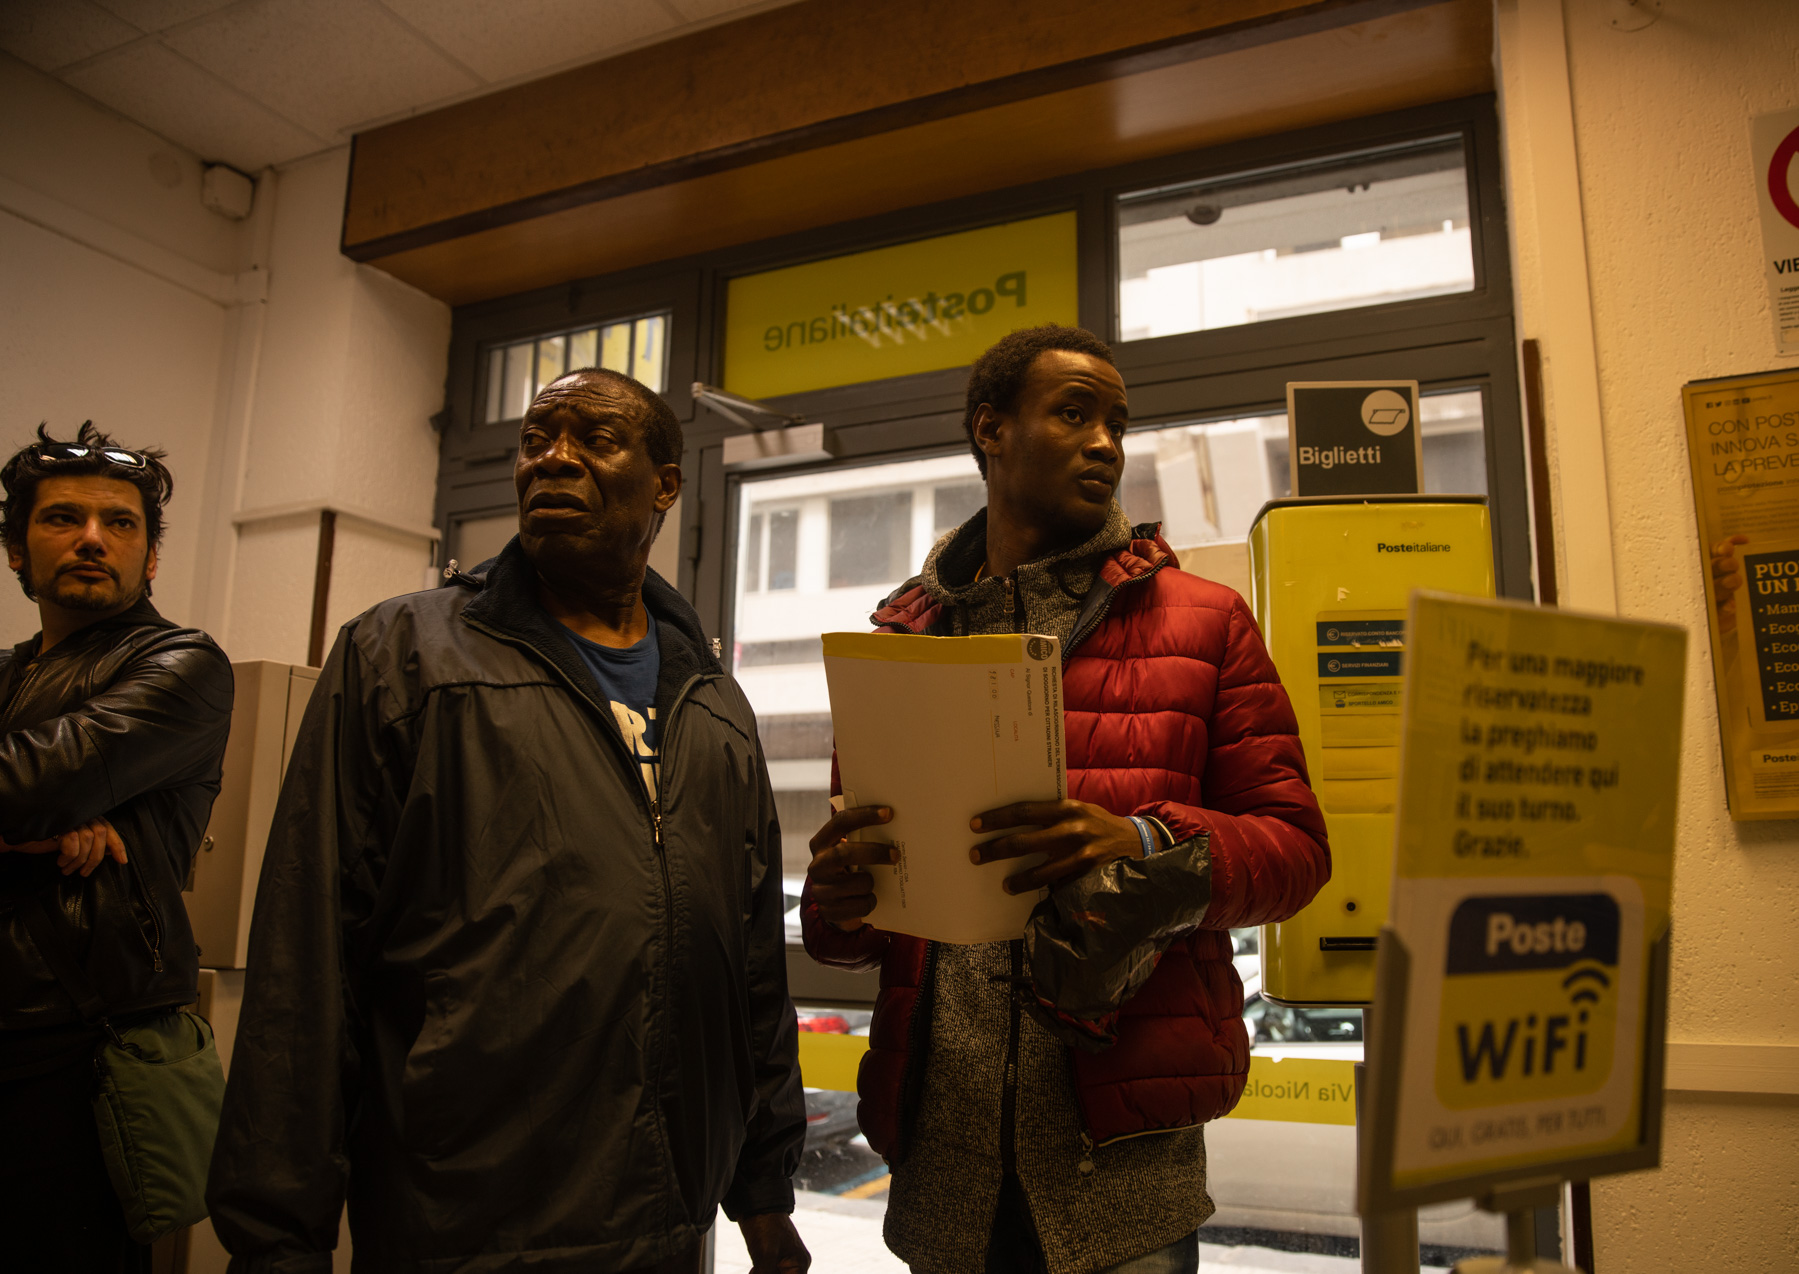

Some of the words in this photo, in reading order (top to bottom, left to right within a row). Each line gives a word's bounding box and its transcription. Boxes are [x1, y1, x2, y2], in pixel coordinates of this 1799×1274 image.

[1708, 418, 1750, 436] CON
[1711, 435, 1781, 456] INNOVA
[1299, 446, 1381, 469] Biglietti
[1714, 461, 1738, 476] LA
[1377, 542, 1451, 553] Posteitaliane
[1754, 561, 1799, 579] PUO
[1756, 578, 1789, 595] UN
[1771, 642, 1799, 654] Eco
[1466, 640, 1502, 667] Per
[1509, 650, 1549, 675] una
[1554, 658, 1645, 688] maggiore
[1463, 684, 1592, 716] riservatezza
[1779, 701, 1799, 714] Ep
[1488, 725, 1597, 754] preghiamo
[1458, 754, 1480, 783] di
[1485, 759, 1584, 787] attendere
[1588, 761, 1620, 794] qui
[1457, 793, 1471, 820] il
[1477, 800, 1514, 821] suo
[1520, 799, 1581, 822] turno.
[1486, 913, 1588, 956] Poste
[1457, 1009, 1589, 1084] WiFi
